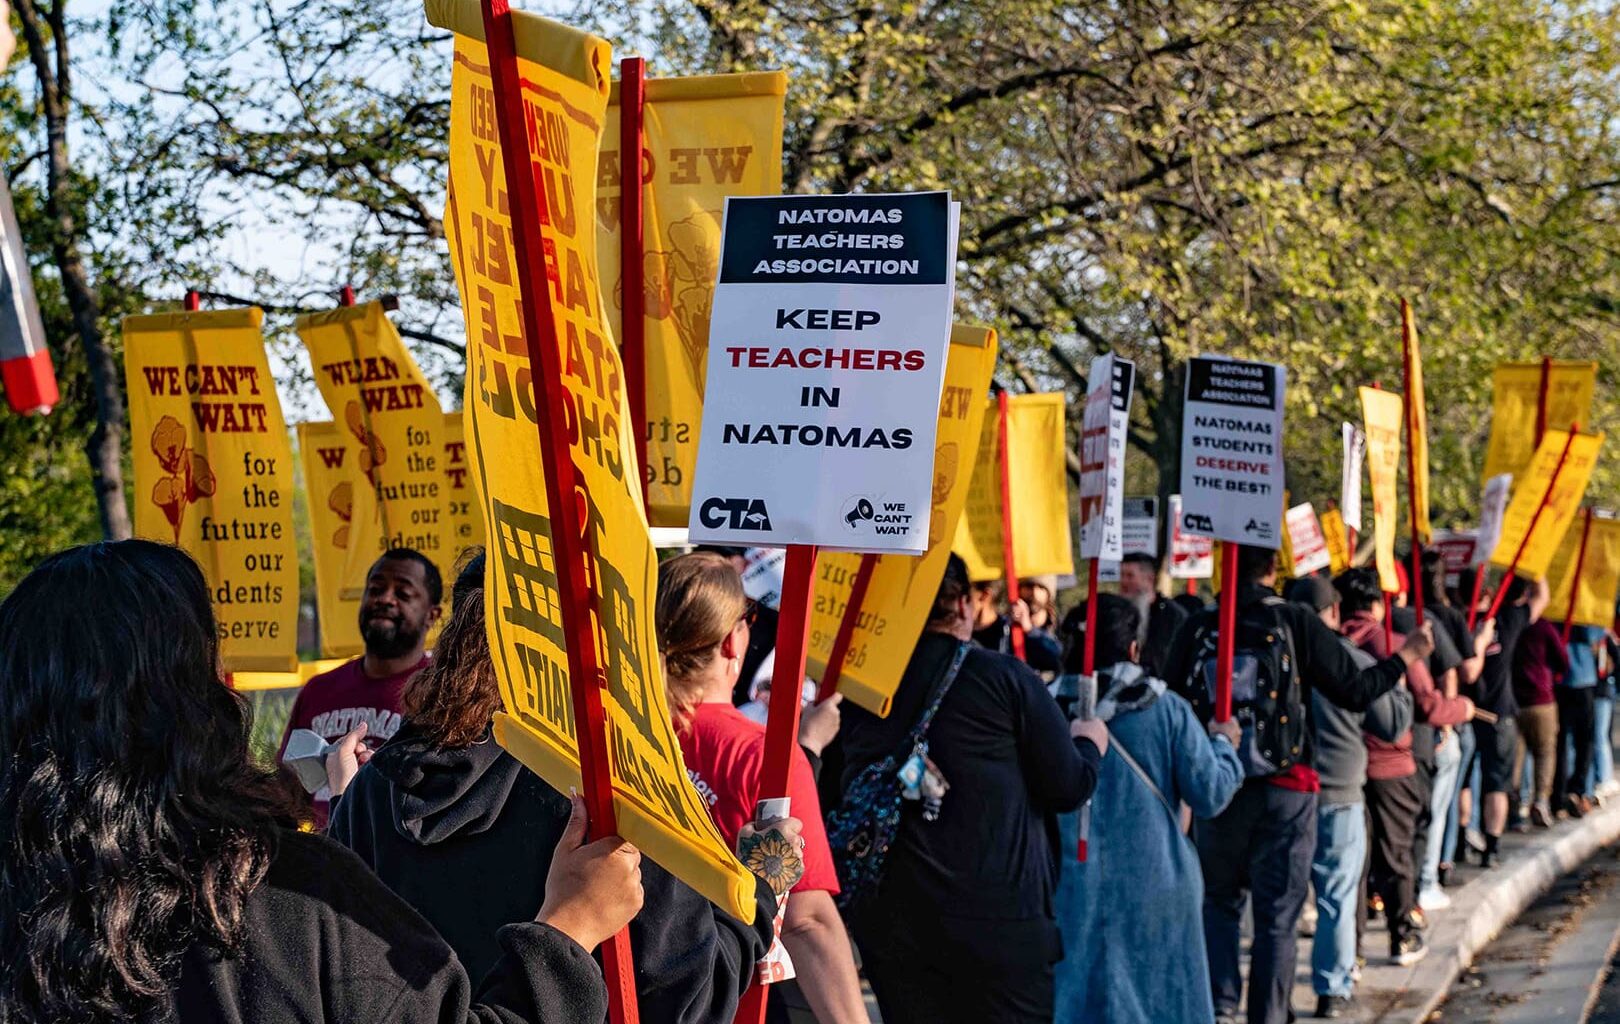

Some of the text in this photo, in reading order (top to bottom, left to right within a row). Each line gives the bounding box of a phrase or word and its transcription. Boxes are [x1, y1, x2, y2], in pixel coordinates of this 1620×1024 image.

[778, 208, 904, 225] NATOMAS
[773, 233, 905, 249] TEACHERS
[752, 259, 919, 275] ASSOCIATION
[775, 309, 881, 331] KEEP
[726, 347, 926, 371] TEACHERS
[142, 363, 261, 396] WE CAN'T
[361, 384, 424, 414] WAIT
[800, 386, 841, 408] IN
[191, 402, 268, 433] WAIT
[1194, 416, 1273, 435] NATOMAS
[722, 424, 914, 450] NATOMAS
[1192, 436, 1274, 456] STUDENTS
[244, 451, 277, 477] for
[406, 452, 437, 472] the
[1196, 456, 1270, 476] DESERVE
[1193, 475, 1272, 495] THE BEST!
[243, 483, 280, 508] the
[411, 508, 440, 525] our
[699, 497, 773, 532] CTA
[883, 502, 906, 512] WE
[200, 516, 283, 542] future
[875, 526, 910, 535] WAIT
[1184, 513, 1214, 533] CTA
[244, 553, 284, 572] our
